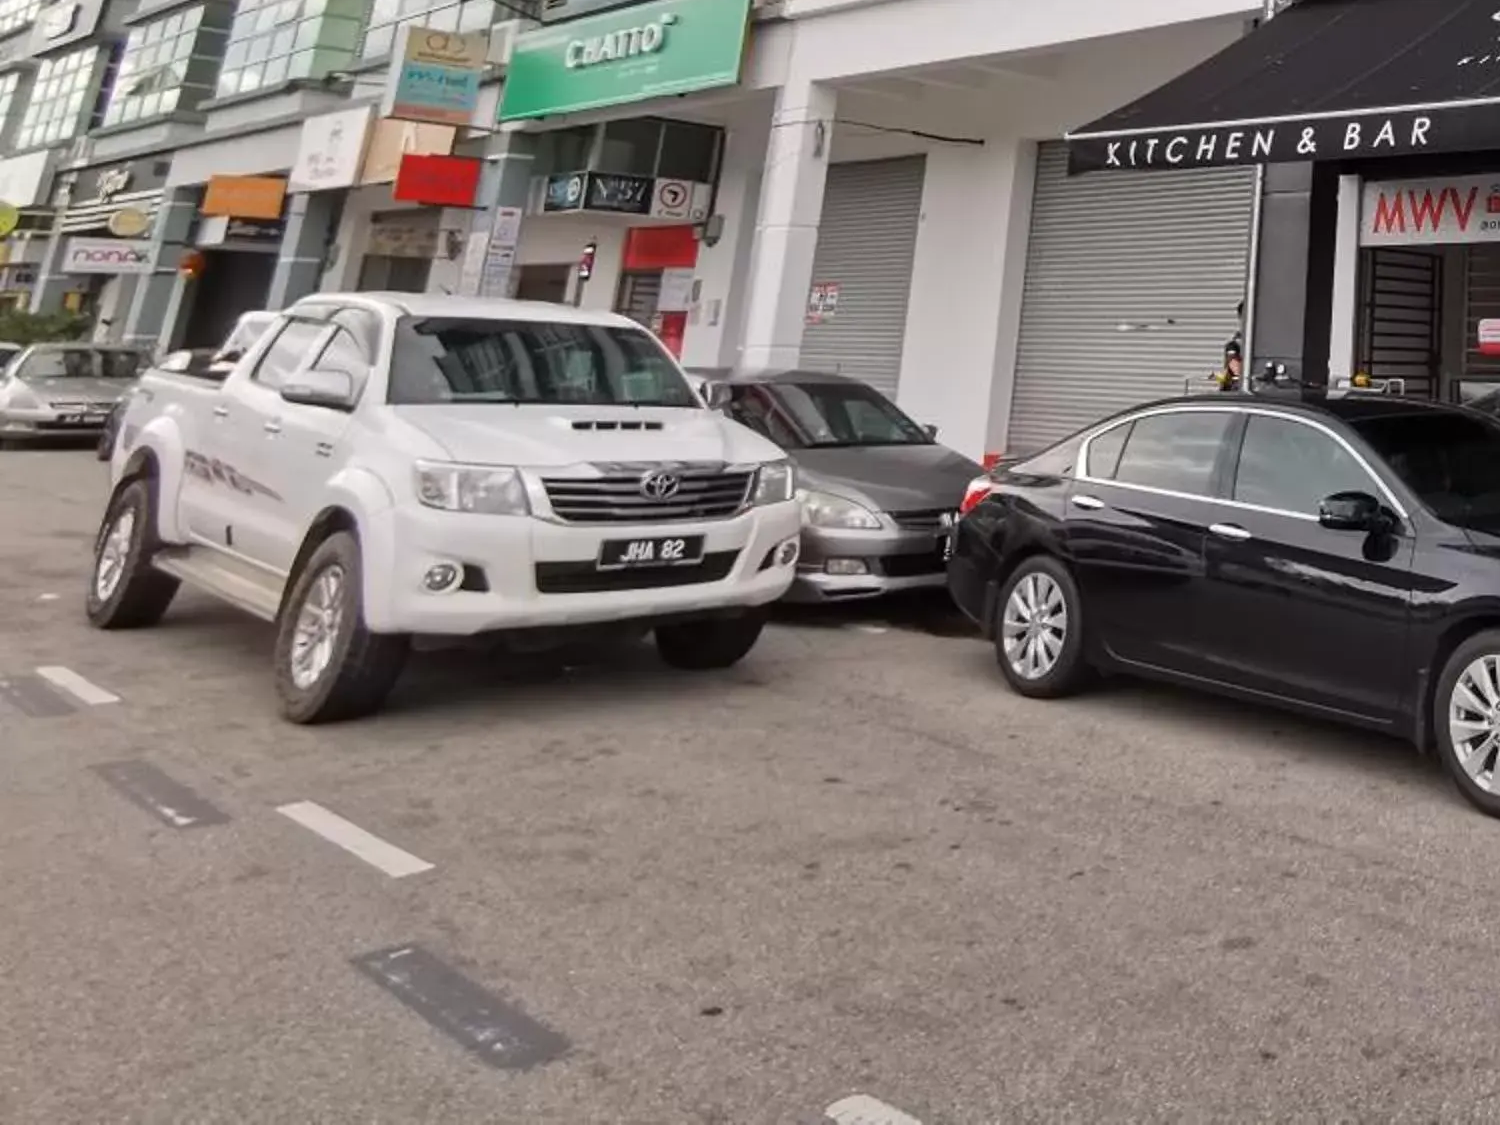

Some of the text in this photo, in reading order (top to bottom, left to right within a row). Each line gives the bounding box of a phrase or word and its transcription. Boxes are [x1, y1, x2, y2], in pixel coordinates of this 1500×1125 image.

[565, 23, 665, 68] CHATTO
[1105, 117, 1432, 166] KITCHEN & BAR
[1372, 186, 1479, 234] MWV
[619, 538, 686, 562] JHA 82
